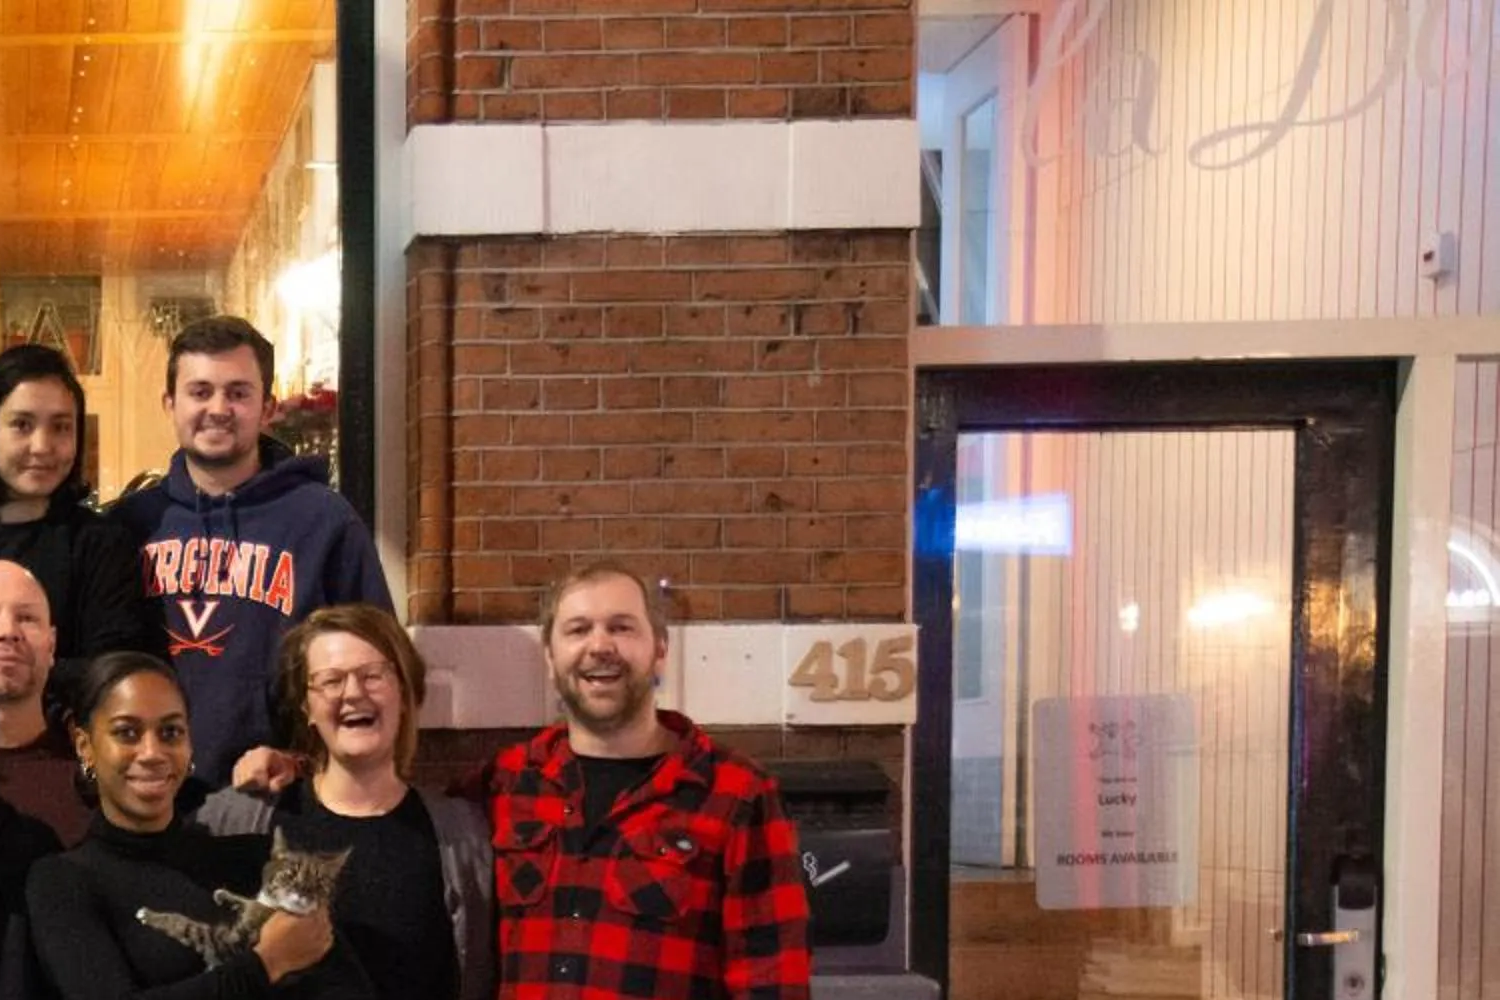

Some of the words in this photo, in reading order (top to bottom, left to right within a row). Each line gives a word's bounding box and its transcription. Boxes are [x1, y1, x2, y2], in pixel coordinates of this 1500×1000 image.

[142, 536, 295, 617] IRGINIA
[177, 600, 220, 639] V
[787, 634, 915, 703] 415
[1097, 793, 1137, 807] Lucky
[1056, 854, 1107, 866] ROOMS
[1110, 852, 1178, 864] AVAILABLE
